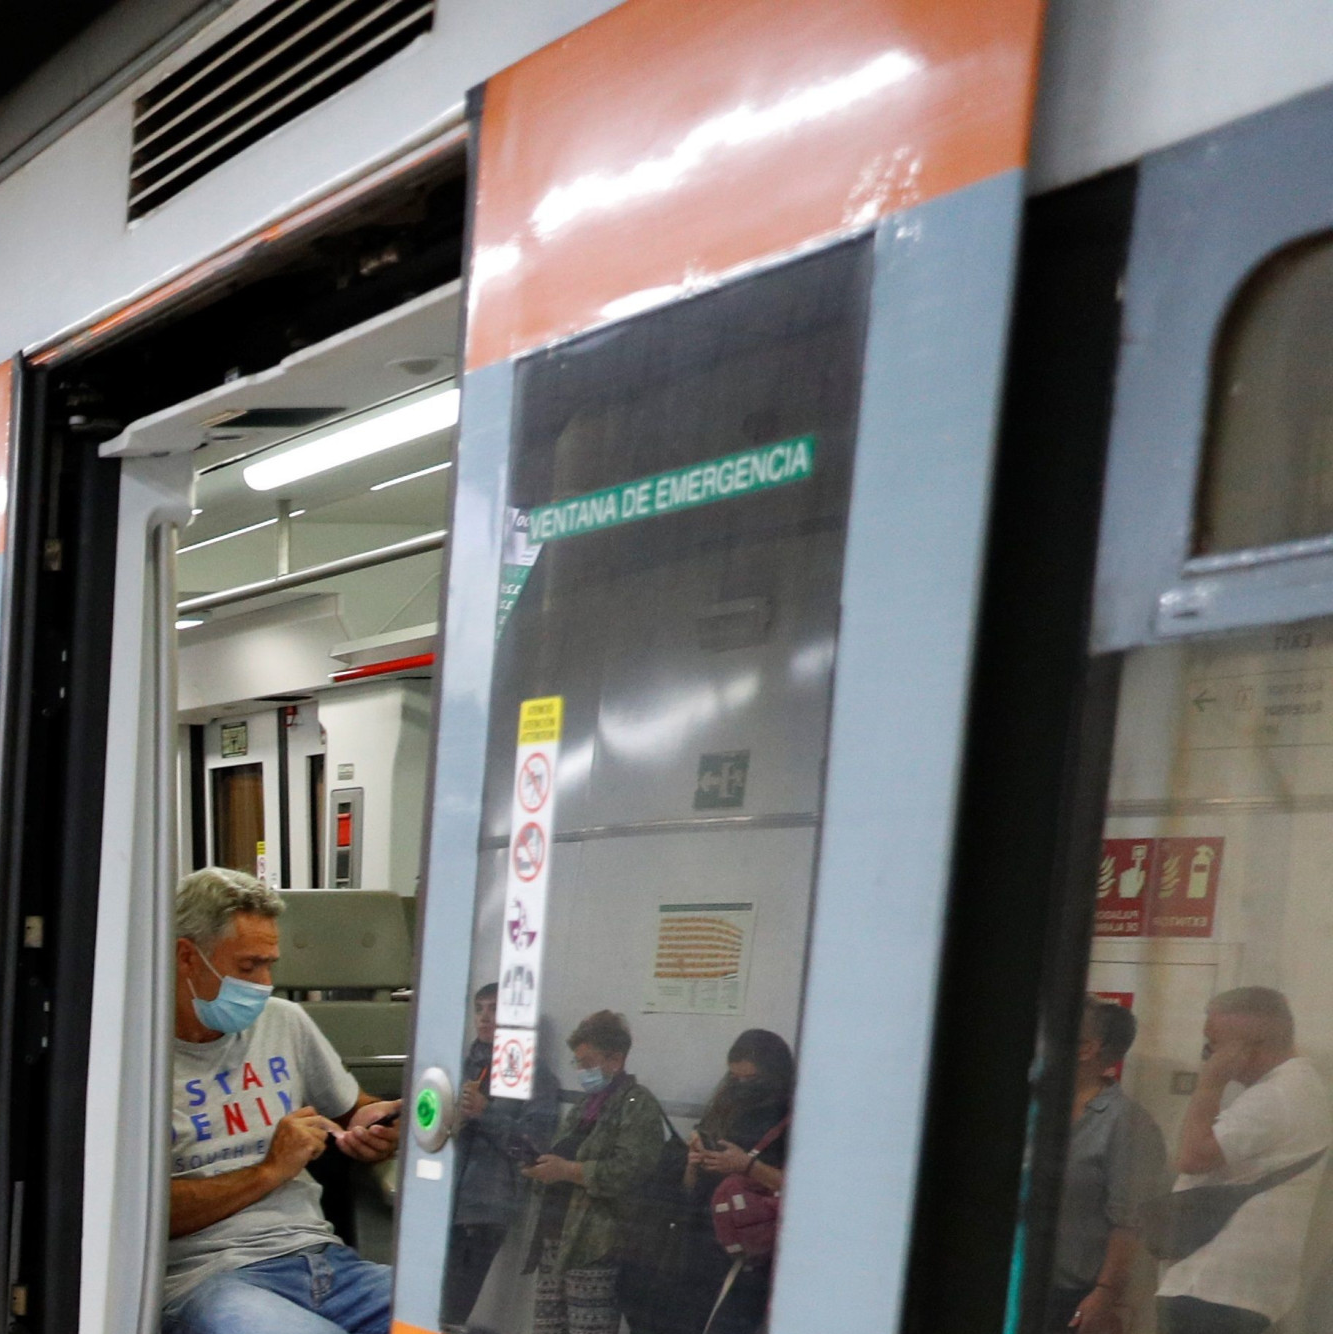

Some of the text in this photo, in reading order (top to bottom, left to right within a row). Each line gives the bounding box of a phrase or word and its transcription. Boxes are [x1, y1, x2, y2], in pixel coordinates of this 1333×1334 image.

[530, 493, 617, 542] VENTANA
[621, 482, 652, 519] DE
[654, 441, 809, 511] EMERGENCIA
[185, 1056, 290, 1107] STAR
[175, 1145, 245, 1173] SOUTH
